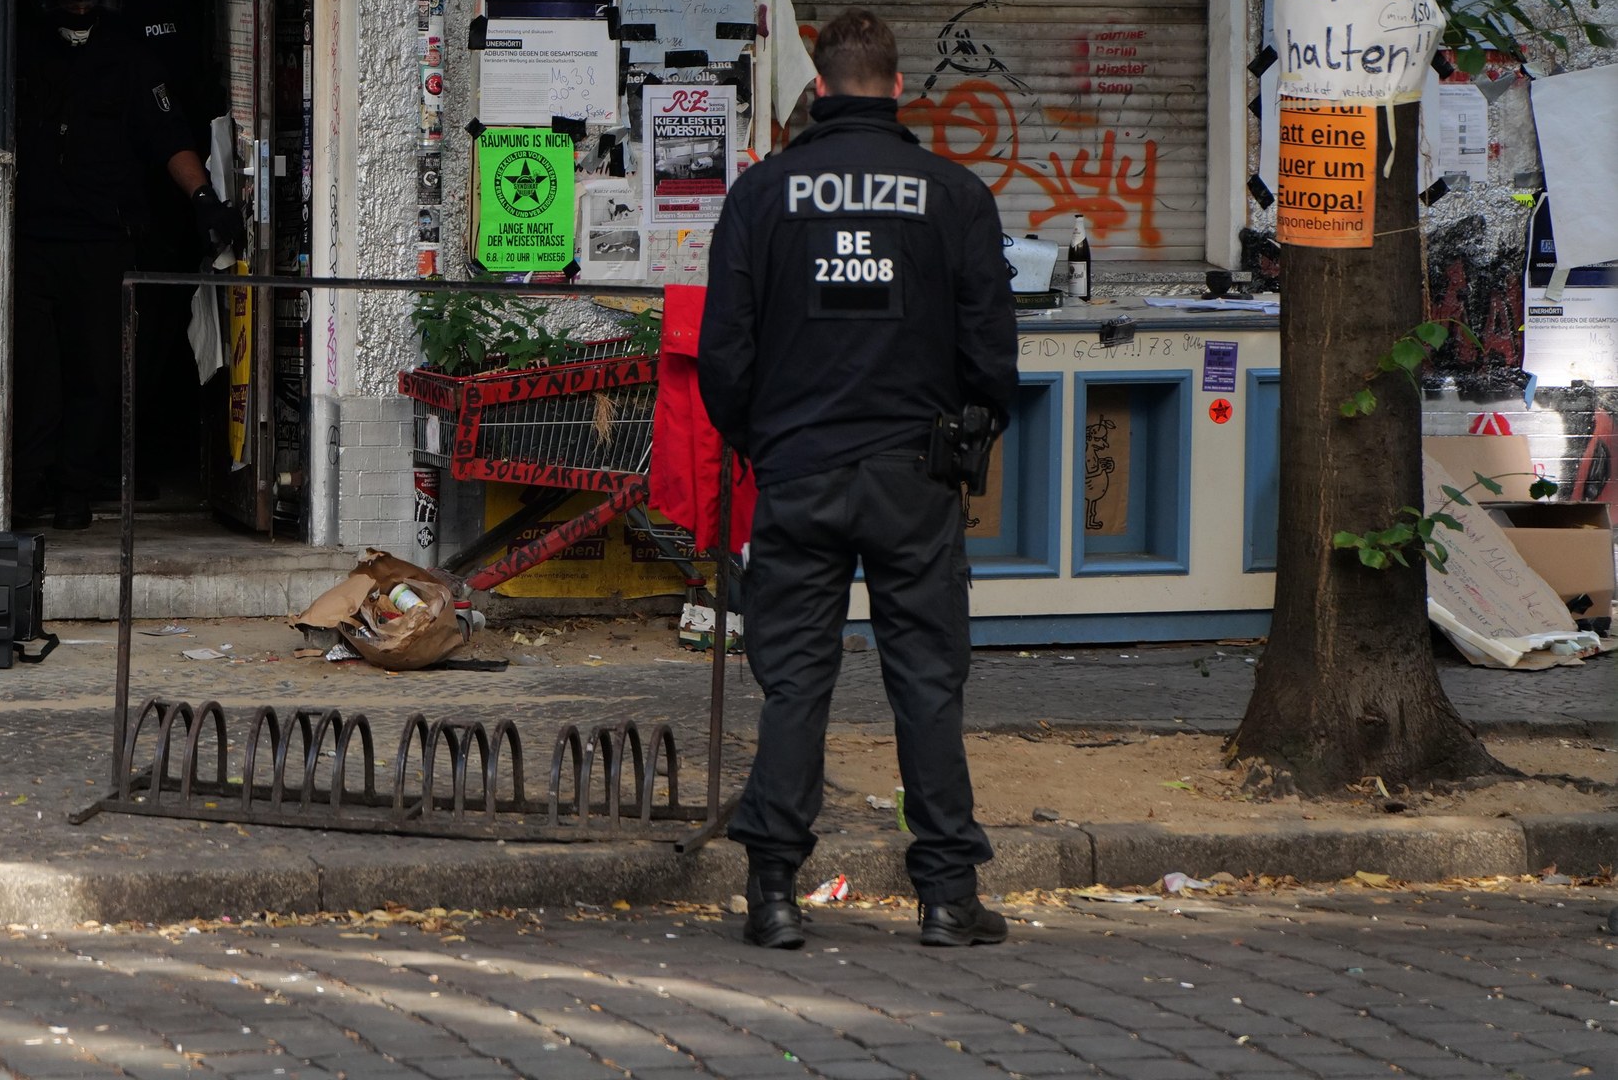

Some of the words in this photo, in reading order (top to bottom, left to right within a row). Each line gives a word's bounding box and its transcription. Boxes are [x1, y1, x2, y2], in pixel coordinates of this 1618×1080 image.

[1095, 63, 1148, 75] Hipster
[655, 117, 681, 125] KIEZ
[682, 117, 725, 125] LEISTET
[482, 132, 529, 147] RÄUMUNG
[533, 134, 541, 147] IS
[545, 134, 570, 147] NICH!
[655, 126, 725, 136] WIDERSTAND!
[1312, 125, 1365, 146] eine
[496, 151, 527, 180] KIEZKULTUR
[528, 151, 541, 161] VON
[542, 157, 555, 181] UNTEN
[1324, 160, 1364, 178] um
[495, 185, 515, 215] ERHALTEN
[515, 210, 528, 218] UND
[529, 185, 557, 217] VERTEIDIGEN
[789, 173, 927, 215] POLIZEI
[499, 223, 524, 234] LANGE
[527, 223, 554, 234] NACHT
[488, 235, 502, 246] DER
[506, 235, 565, 247] WEISESTRASSE
[837, 231, 871, 255] BE
[486, 253, 498, 262] 6.8.
[506, 253, 515, 262] 20
[517, 253, 530, 262] UHR
[537, 253, 565, 262] WEISE56
[815, 258, 894, 282] 22008
[508, 359, 658, 399] SYNDIKAT
[403, 376, 450, 407] SYNDIKAT
